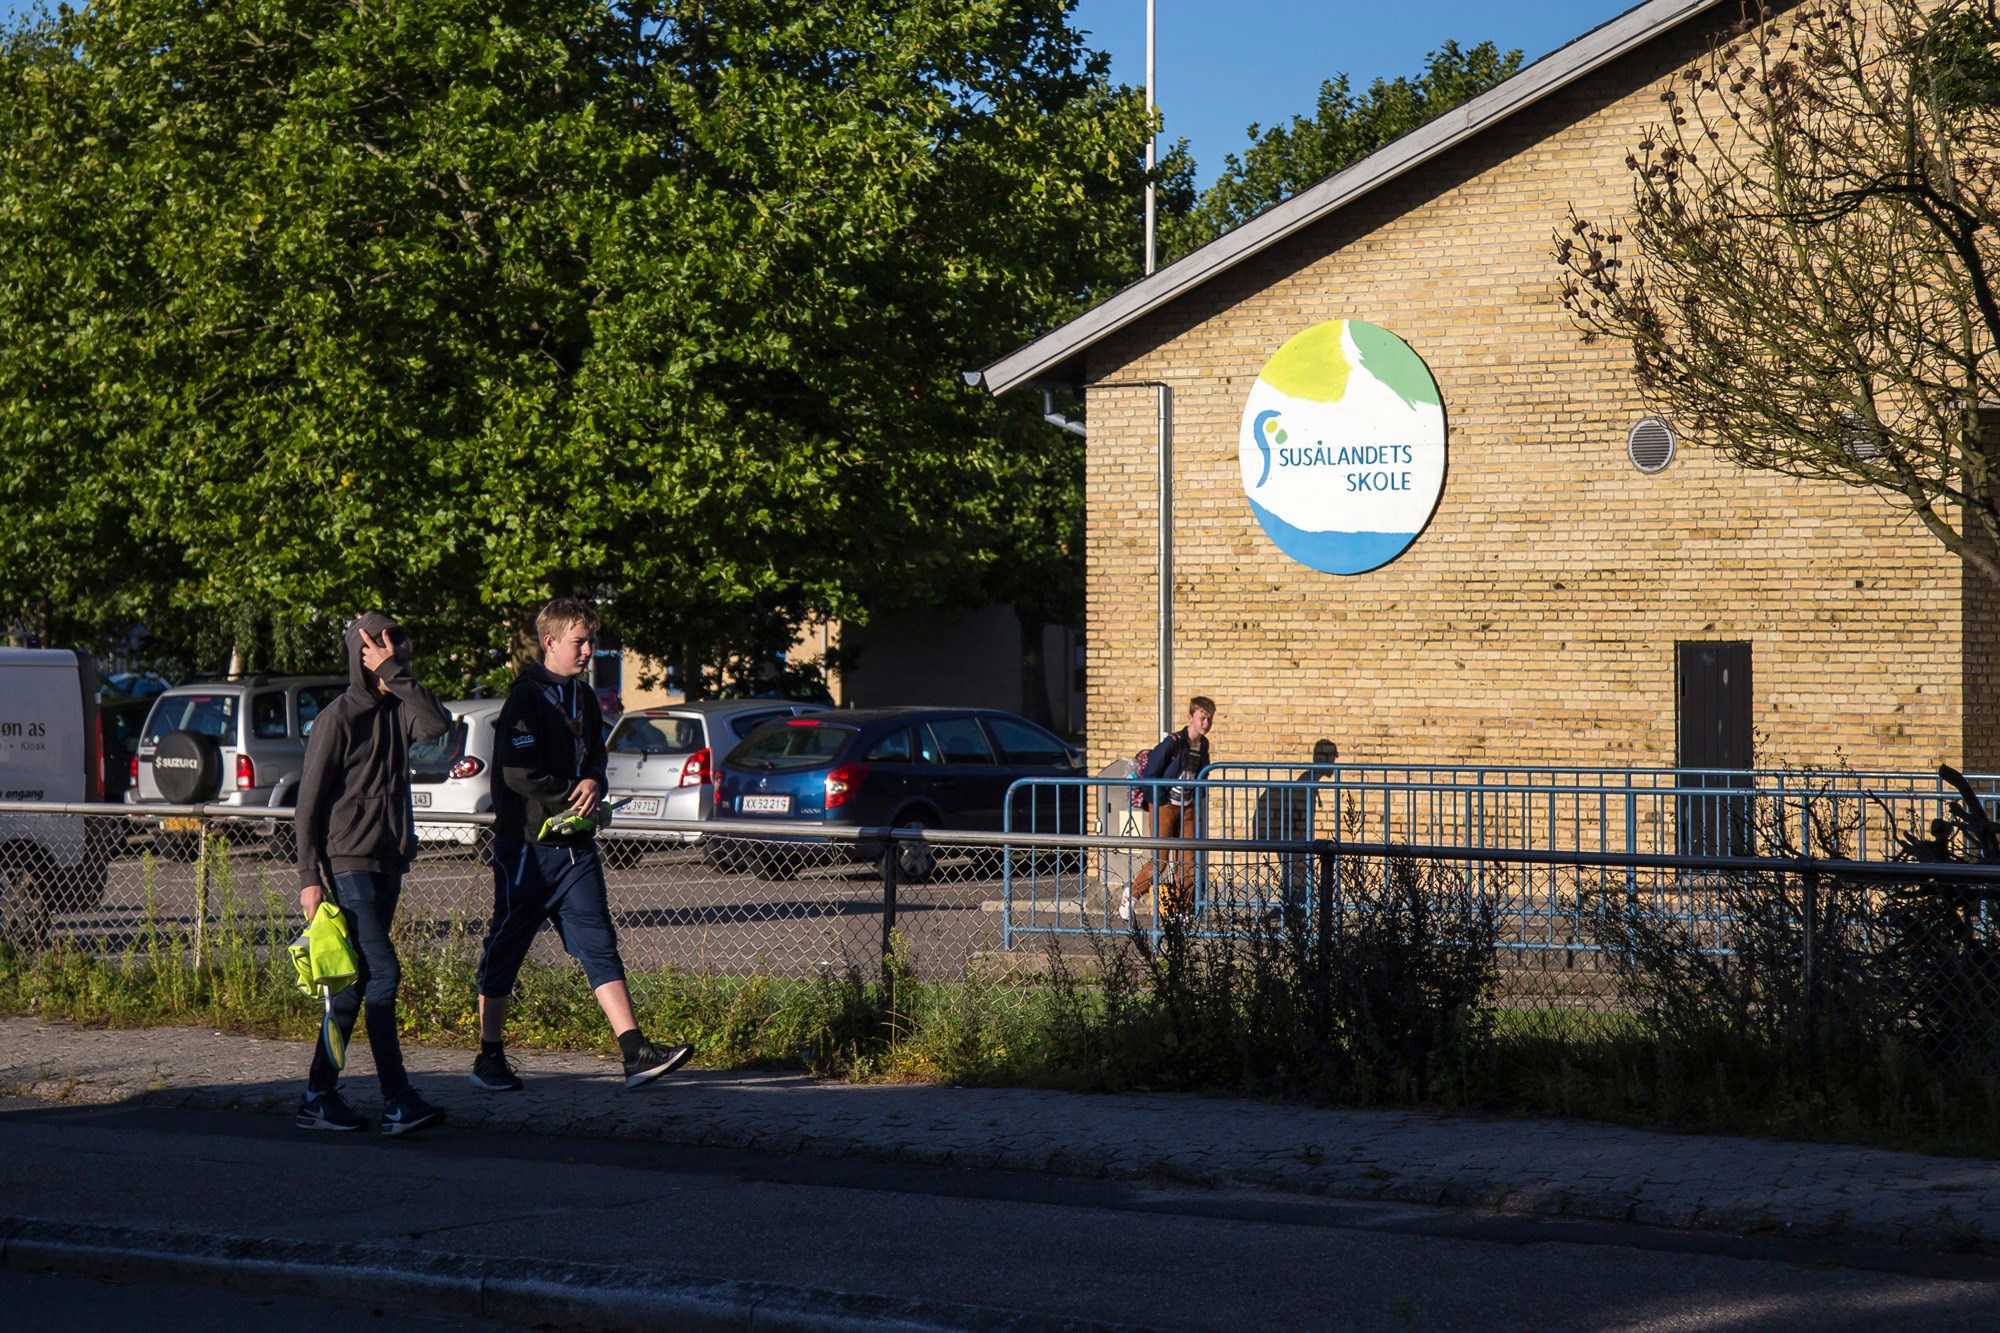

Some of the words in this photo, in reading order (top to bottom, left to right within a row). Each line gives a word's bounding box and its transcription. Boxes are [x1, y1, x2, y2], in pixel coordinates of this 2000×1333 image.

[1280, 440, 1412, 467] SUSÅLANDETS
[1347, 472, 1411, 492] SKOLE
[28, 722, 46, 737] as
[162, 757, 198, 769] SUZUKI
